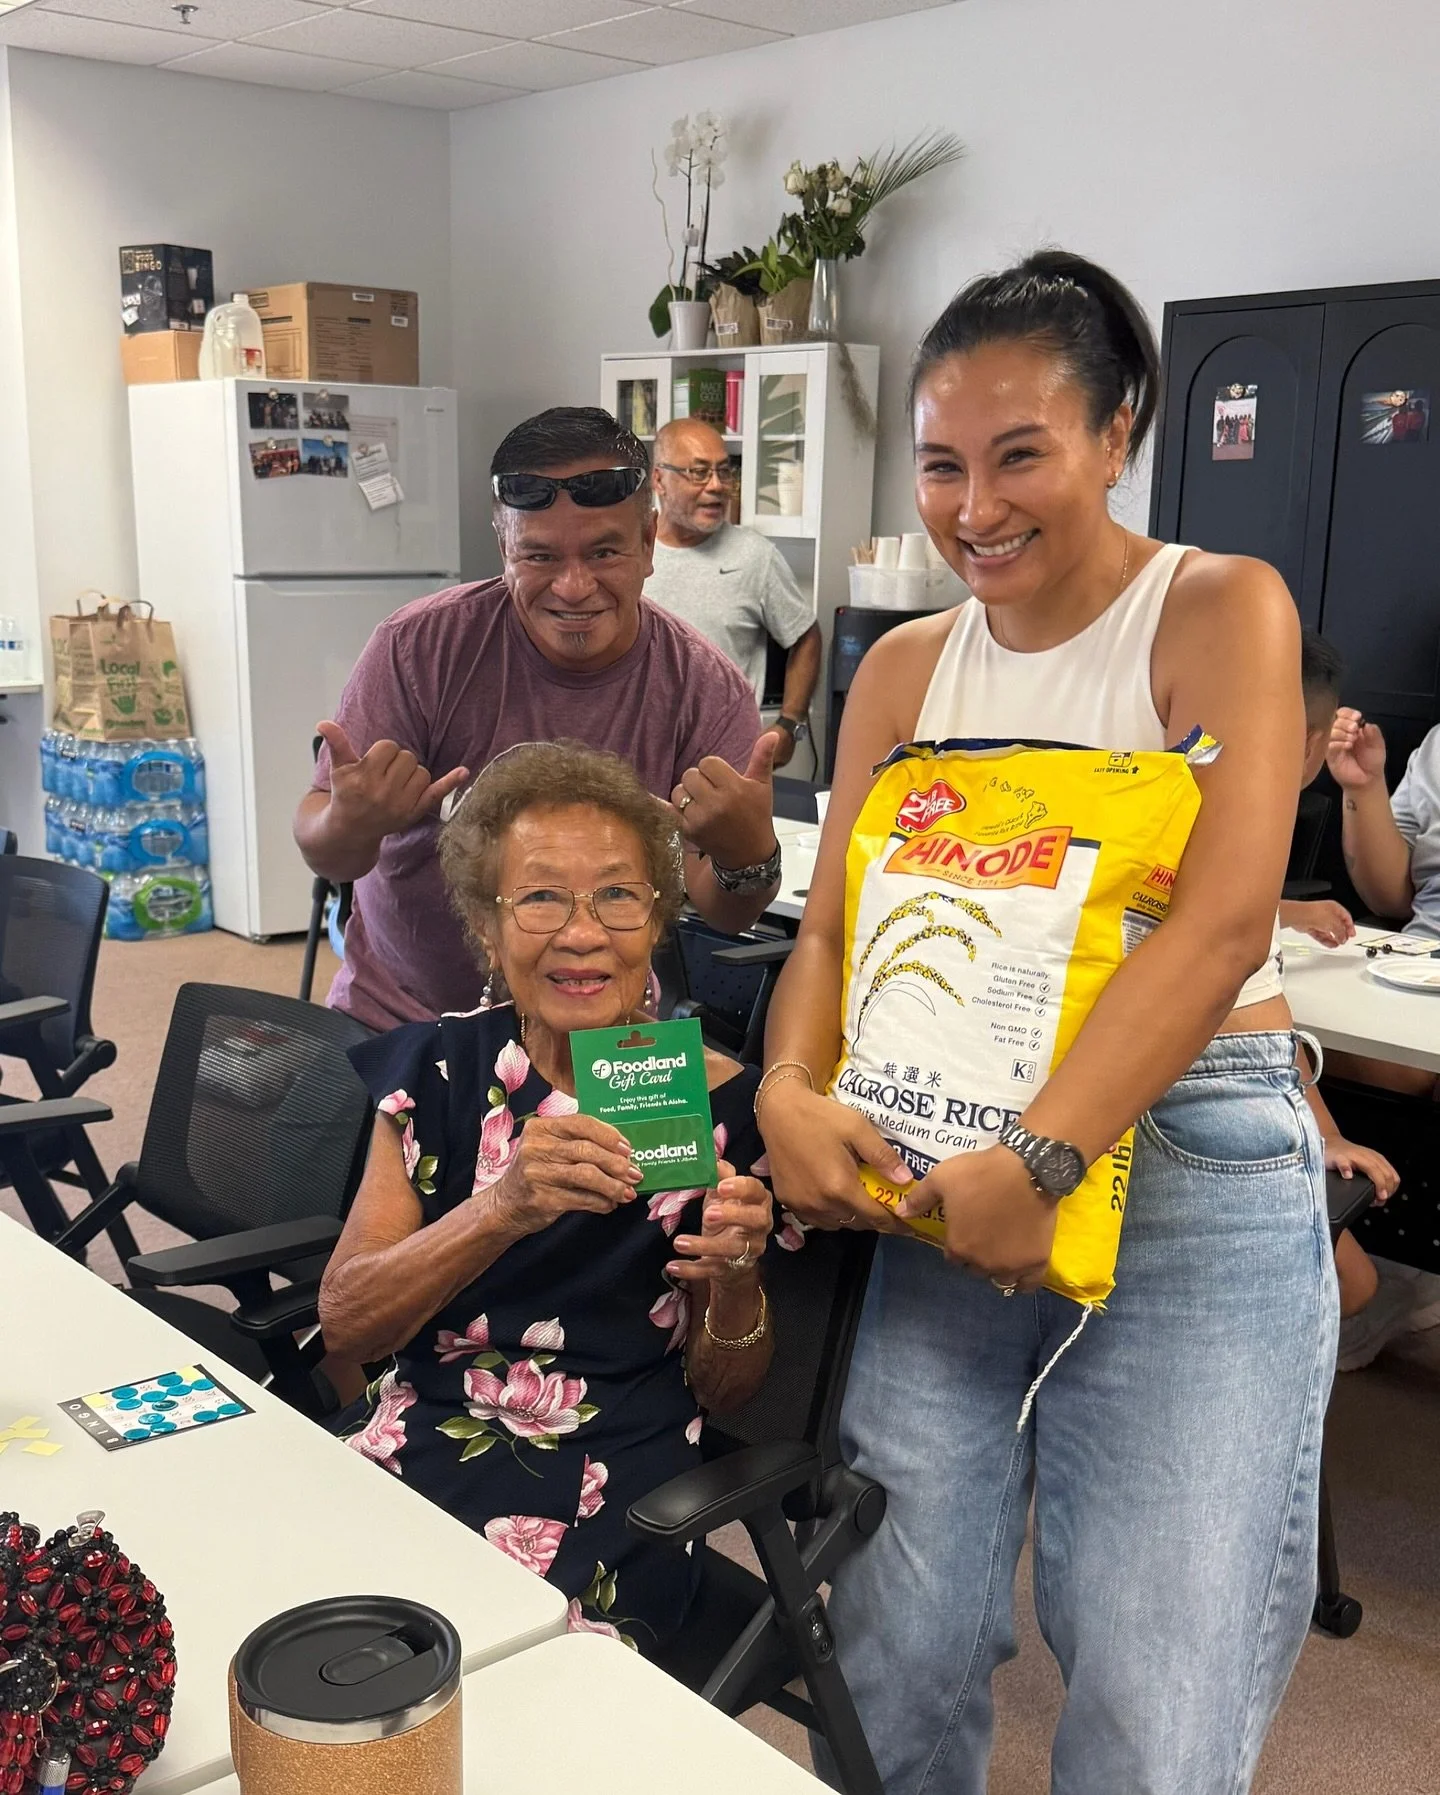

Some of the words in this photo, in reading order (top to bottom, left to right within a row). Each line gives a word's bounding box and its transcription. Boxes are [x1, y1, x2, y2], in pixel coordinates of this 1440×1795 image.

[898, 793, 927, 822] 2
[921, 797, 956, 823] FREE
[902, 835, 1058, 877] HINODE
[942, 870, 975, 886] SINCE
[1151, 868, 1176, 888] HIN
[991, 962, 1008, 972] Rice
[1009, 964, 1016, 973] is
[993, 975, 1017, 986] Gluten
[1019, 979, 1036, 989] Free
[987, 986, 1015, 997] Sodium
[1016, 991, 1033, 1001] Free
[972, 996, 1013, 1010] Cholesterol
[1014, 1003, 1031, 1013] Free
[990, 1022, 1006, 1031] Non
[1008, 1025, 1027, 1035] GMO
[994, 1035, 1005, 1044] Fat
[1008, 1037, 1025, 1047] Free
[613, 1053, 687, 1075] Foodland
[1013, 1062, 1028, 1080] K
[609, 1072, 636, 1091] Gift
[639, 1070, 673, 1086] Card
[883, 1062, 943, 1088] 特選米
[620, 1096, 636, 1104] Enjoy
[648, 1093, 659, 1102] gift
[838, 1068, 935, 1119] CALROSE
[640, 1101, 662, 1109] Friends
[878, 1113, 930, 1140] Medium
[935, 1129, 978, 1150] Grain
[875, 1187, 894, 1207] 22
[1110, 1175, 1126, 1213] 22
